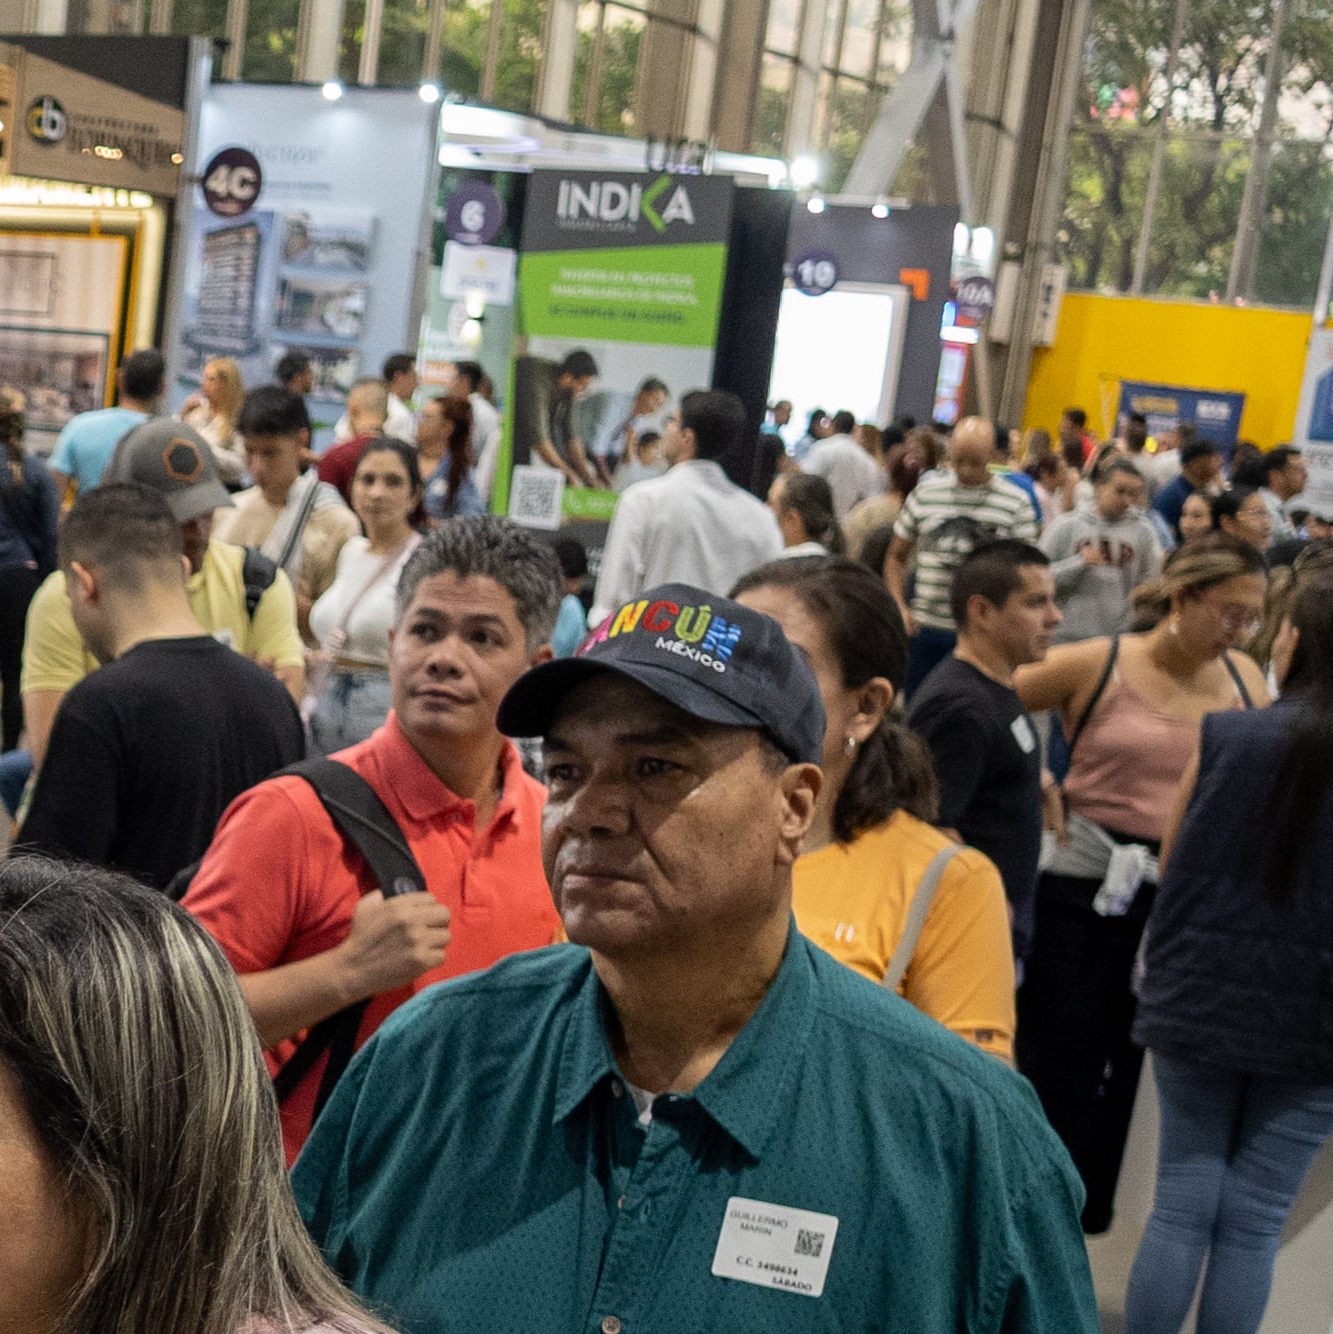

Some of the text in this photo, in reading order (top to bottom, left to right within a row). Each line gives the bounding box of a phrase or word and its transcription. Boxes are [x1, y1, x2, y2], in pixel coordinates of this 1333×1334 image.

[205, 163, 258, 201] 4C
[460, 200, 486, 232] 6
[797, 258, 836, 289] 10
[654, 635, 727, 674] MÉXICO
